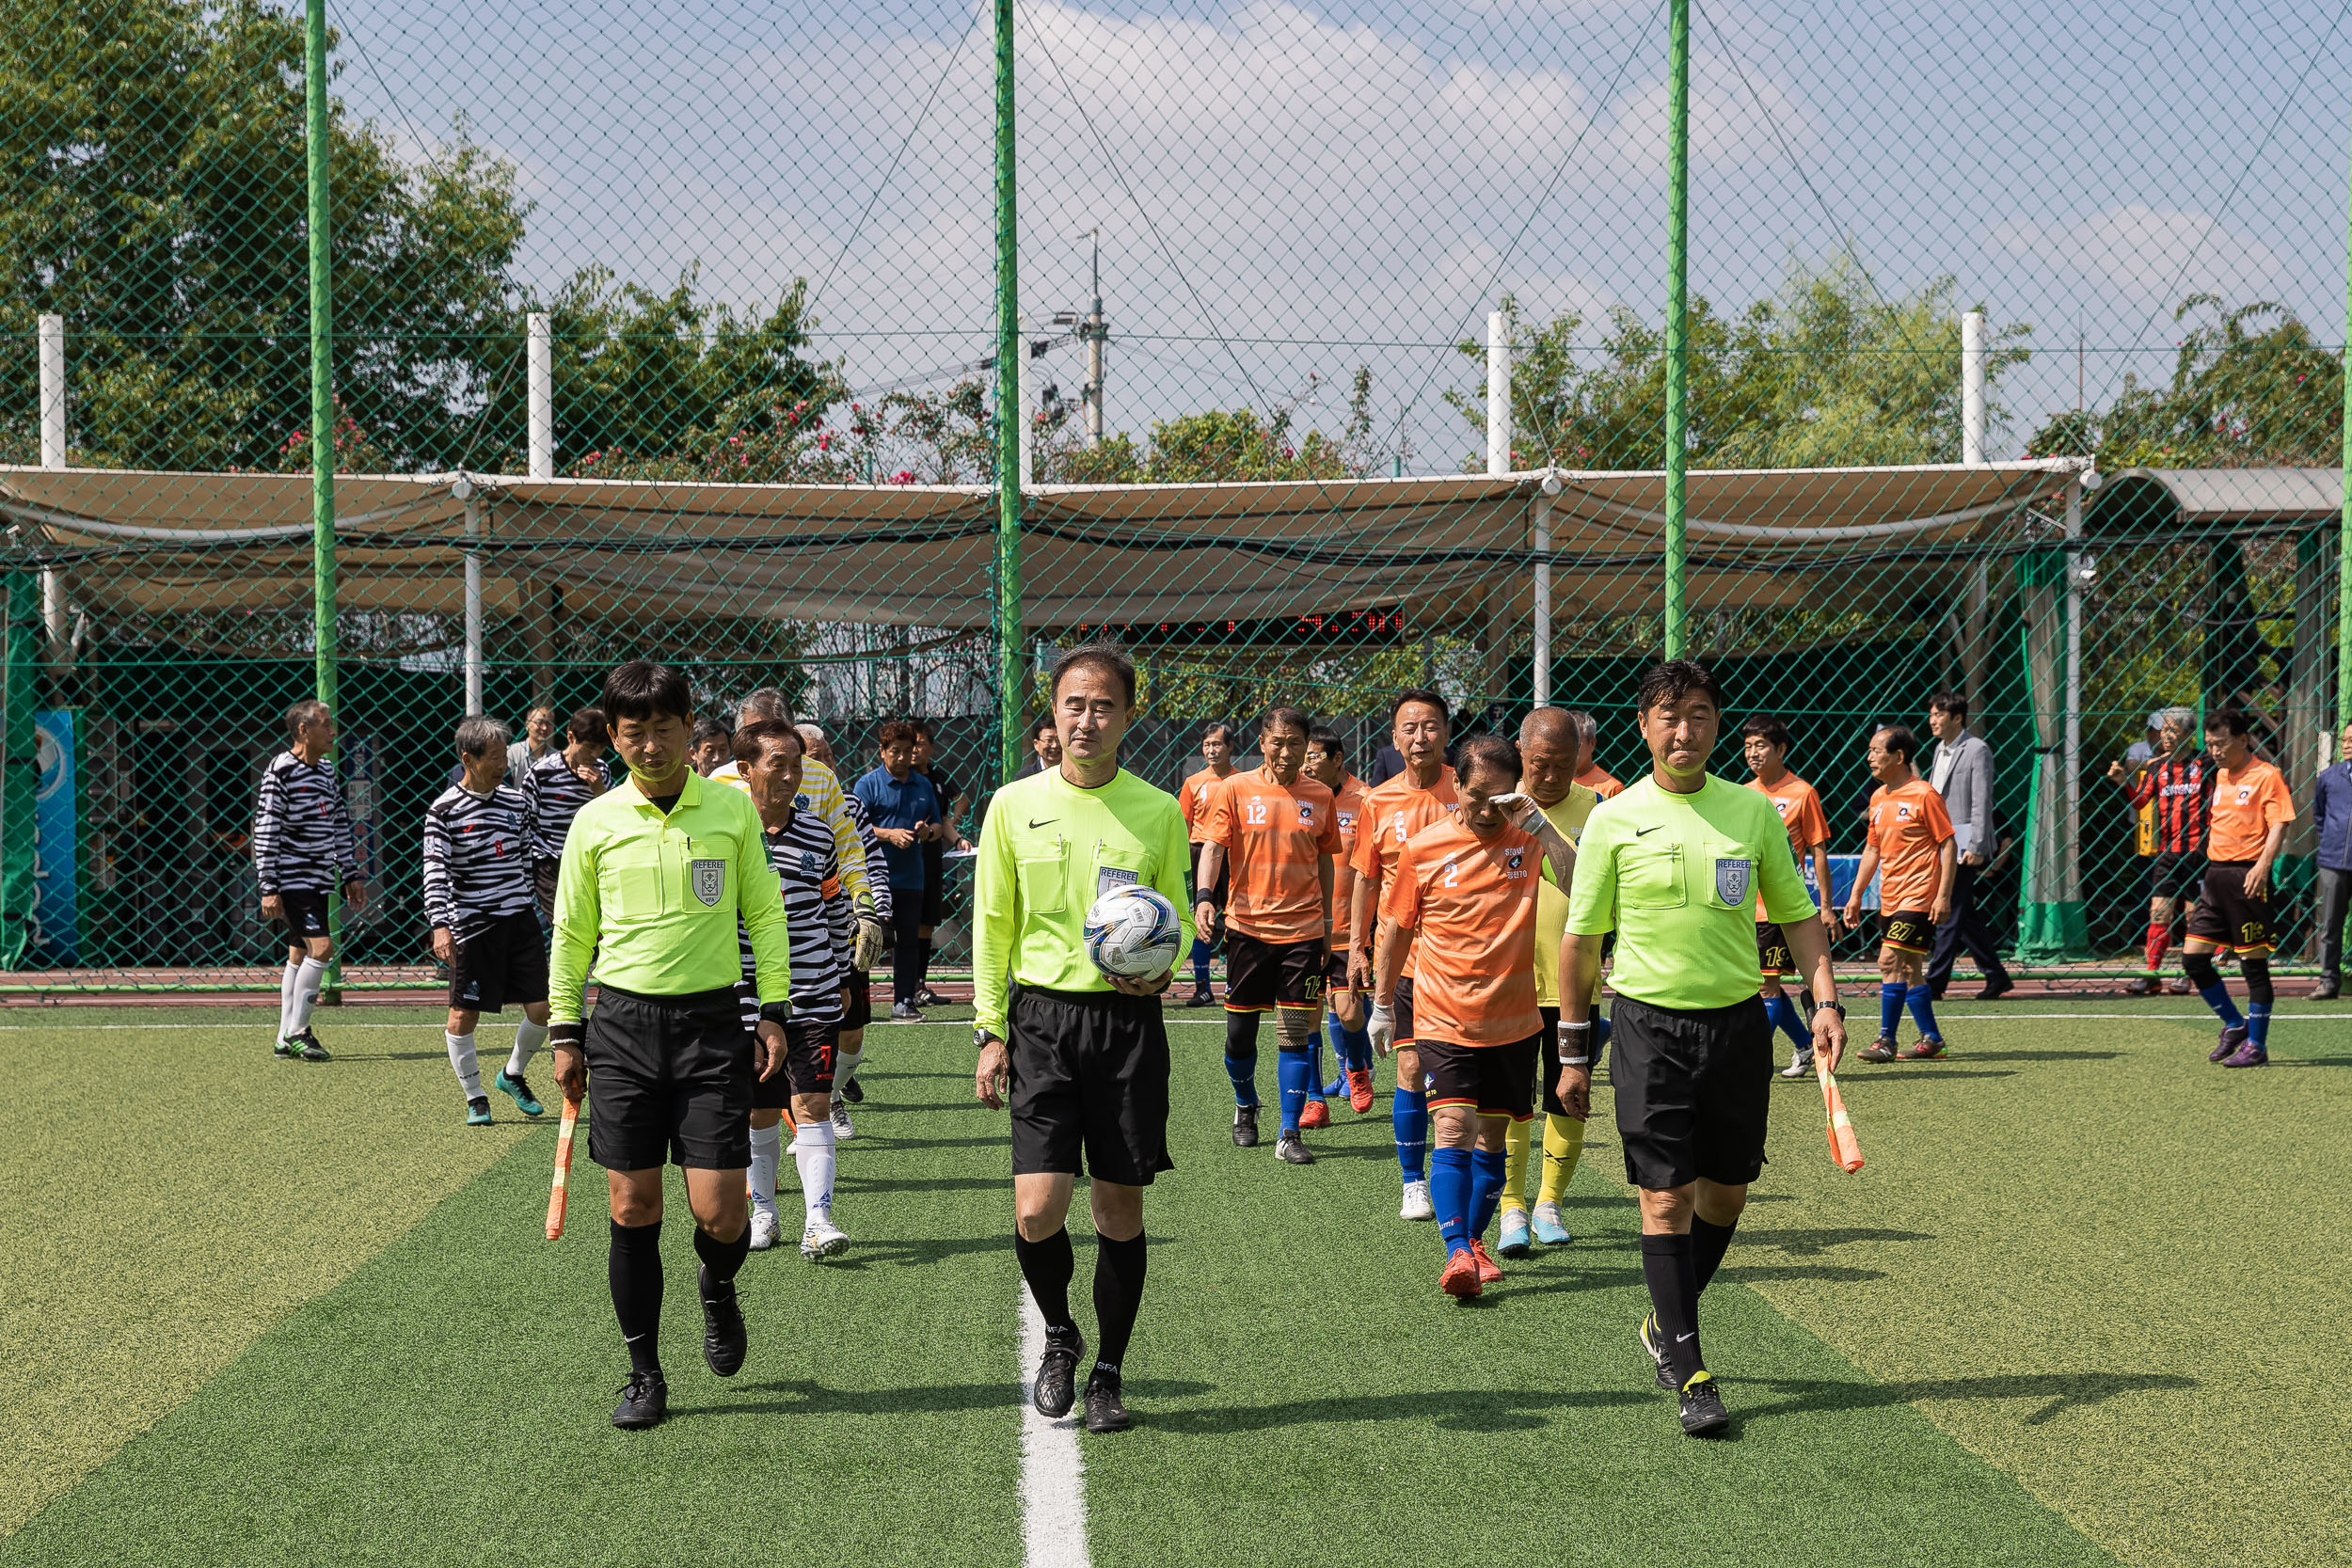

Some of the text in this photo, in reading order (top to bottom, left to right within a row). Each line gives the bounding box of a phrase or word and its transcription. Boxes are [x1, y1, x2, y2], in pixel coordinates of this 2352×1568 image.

[1247, 804, 1267, 824] 12
[1394, 818, 1407, 843] 5
[495, 840, 503, 858] 8
[1505, 846, 1524, 856] SEOUL
[1718, 861, 1750, 869] REFEREE
[1101, 868, 1136, 881] REFEREE
[1445, 863, 1458, 888] 2
[1886, 921, 1916, 942] 27
[1046, 1323, 1068, 1334] SFA
[1096, 1361, 1118, 1374] SFA
